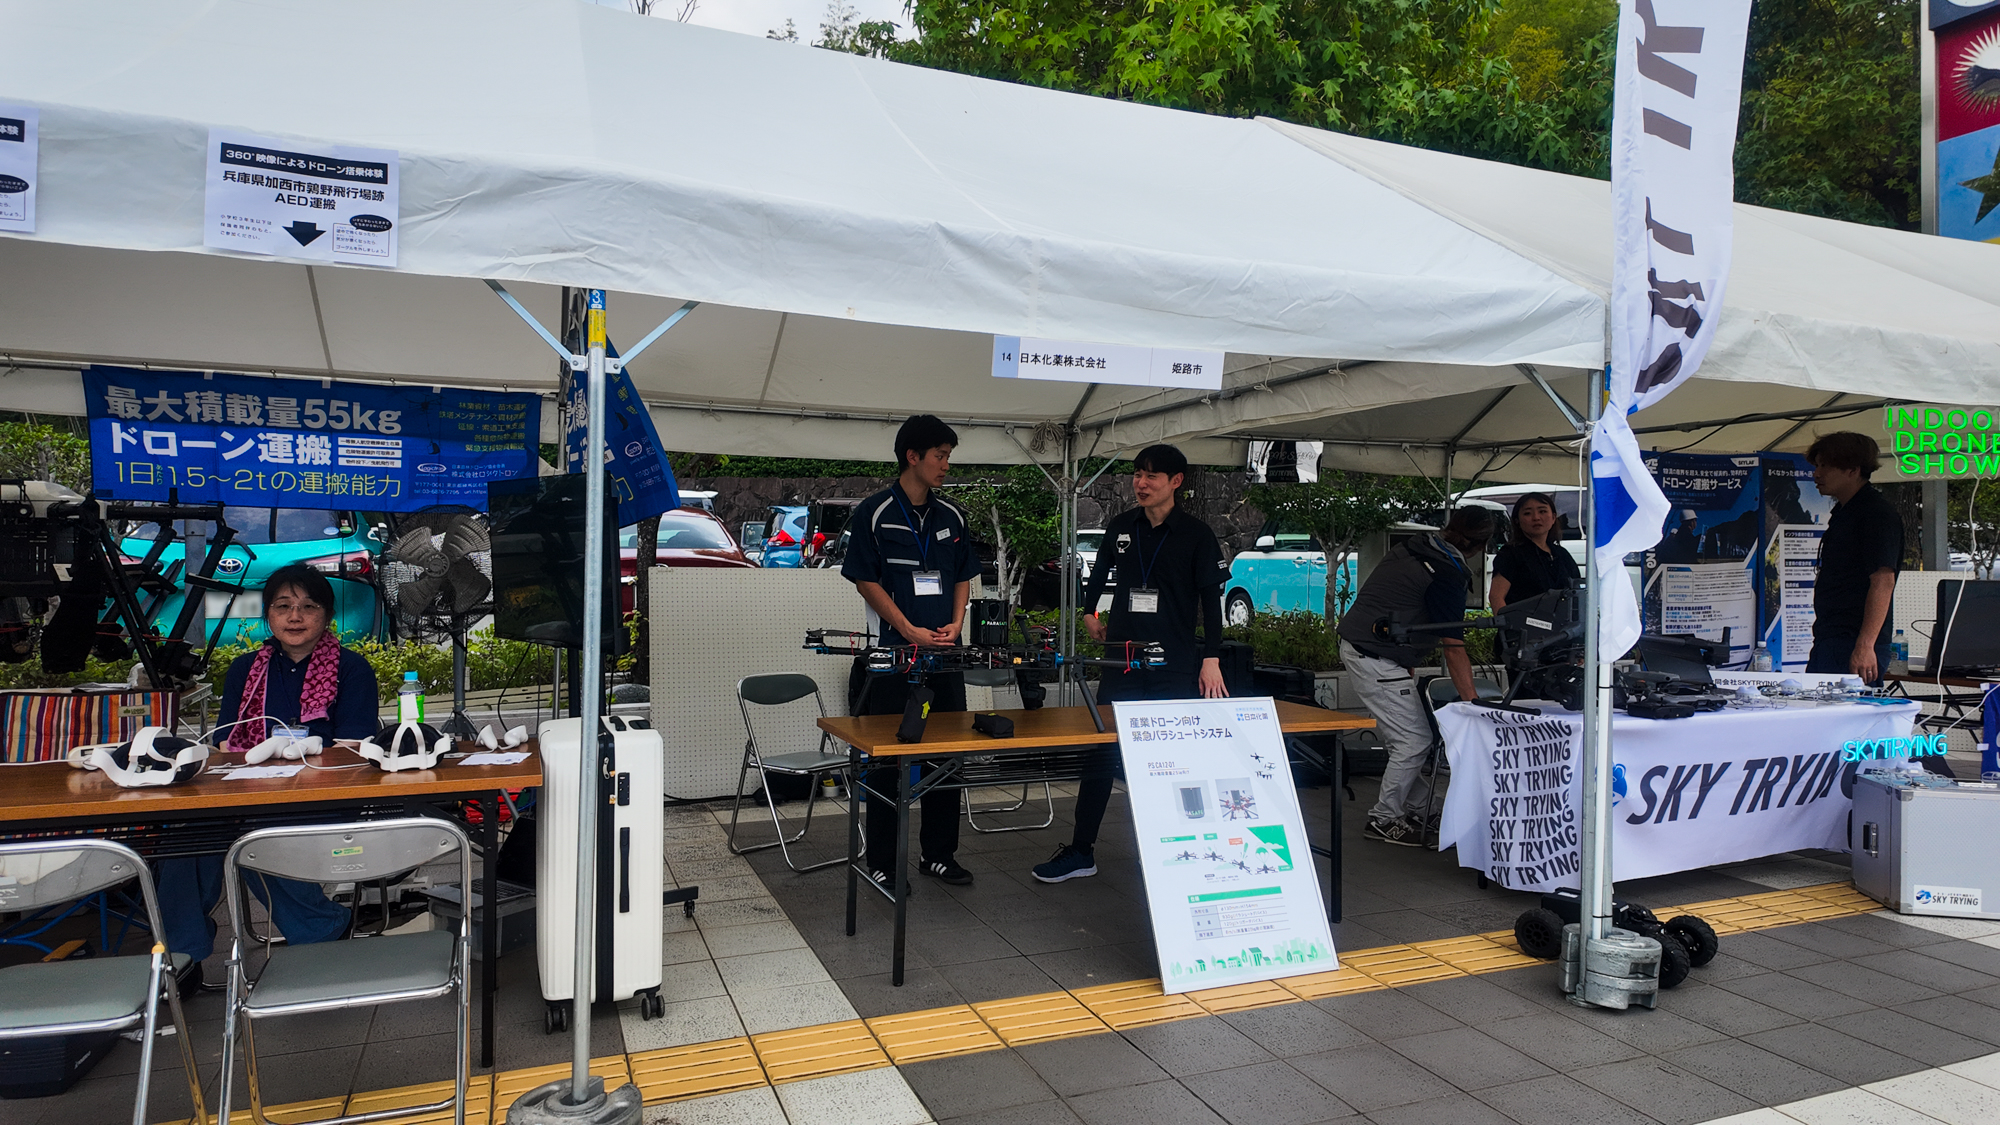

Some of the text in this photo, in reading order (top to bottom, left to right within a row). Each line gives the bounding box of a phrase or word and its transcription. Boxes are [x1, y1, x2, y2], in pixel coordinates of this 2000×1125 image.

[275, 192, 336, 210] AED運搬
[1001, 352, 1203, 376] 14 日本化薬株式会社 姫路市
[104, 385, 402, 435] 最大積載量55kg
[1888, 408, 2000, 432] INDOO
[111, 422, 332, 466] ドローン運搬
[1896, 431, 2000, 454] DRONE
[1900, 453, 2000, 475] SHOW
[1662, 477, 1742, 490] ドローン運搬サービス
[1129, 715, 1201, 729] 産業ドローン向け
[1131, 728, 1233, 742] 緊急パラシュートシステム
[1495, 720, 1572, 748] SKY TRYING
[1493, 740, 1571, 770] SKY TRYING
[1842, 734, 1948, 762] SKYTRYING
[1494, 765, 1573, 793] SKY TRYING
[1490, 788, 1570, 817] SKY TRYING
[1626, 762, 1732, 825] SKY
[1489, 804, 1574, 839] SKY TRYING
[1490, 825, 1577, 862] SKY TRYING
[1491, 851, 1579, 886] SKY TRYING
[1932, 895, 1979, 906] SKY TRYING
